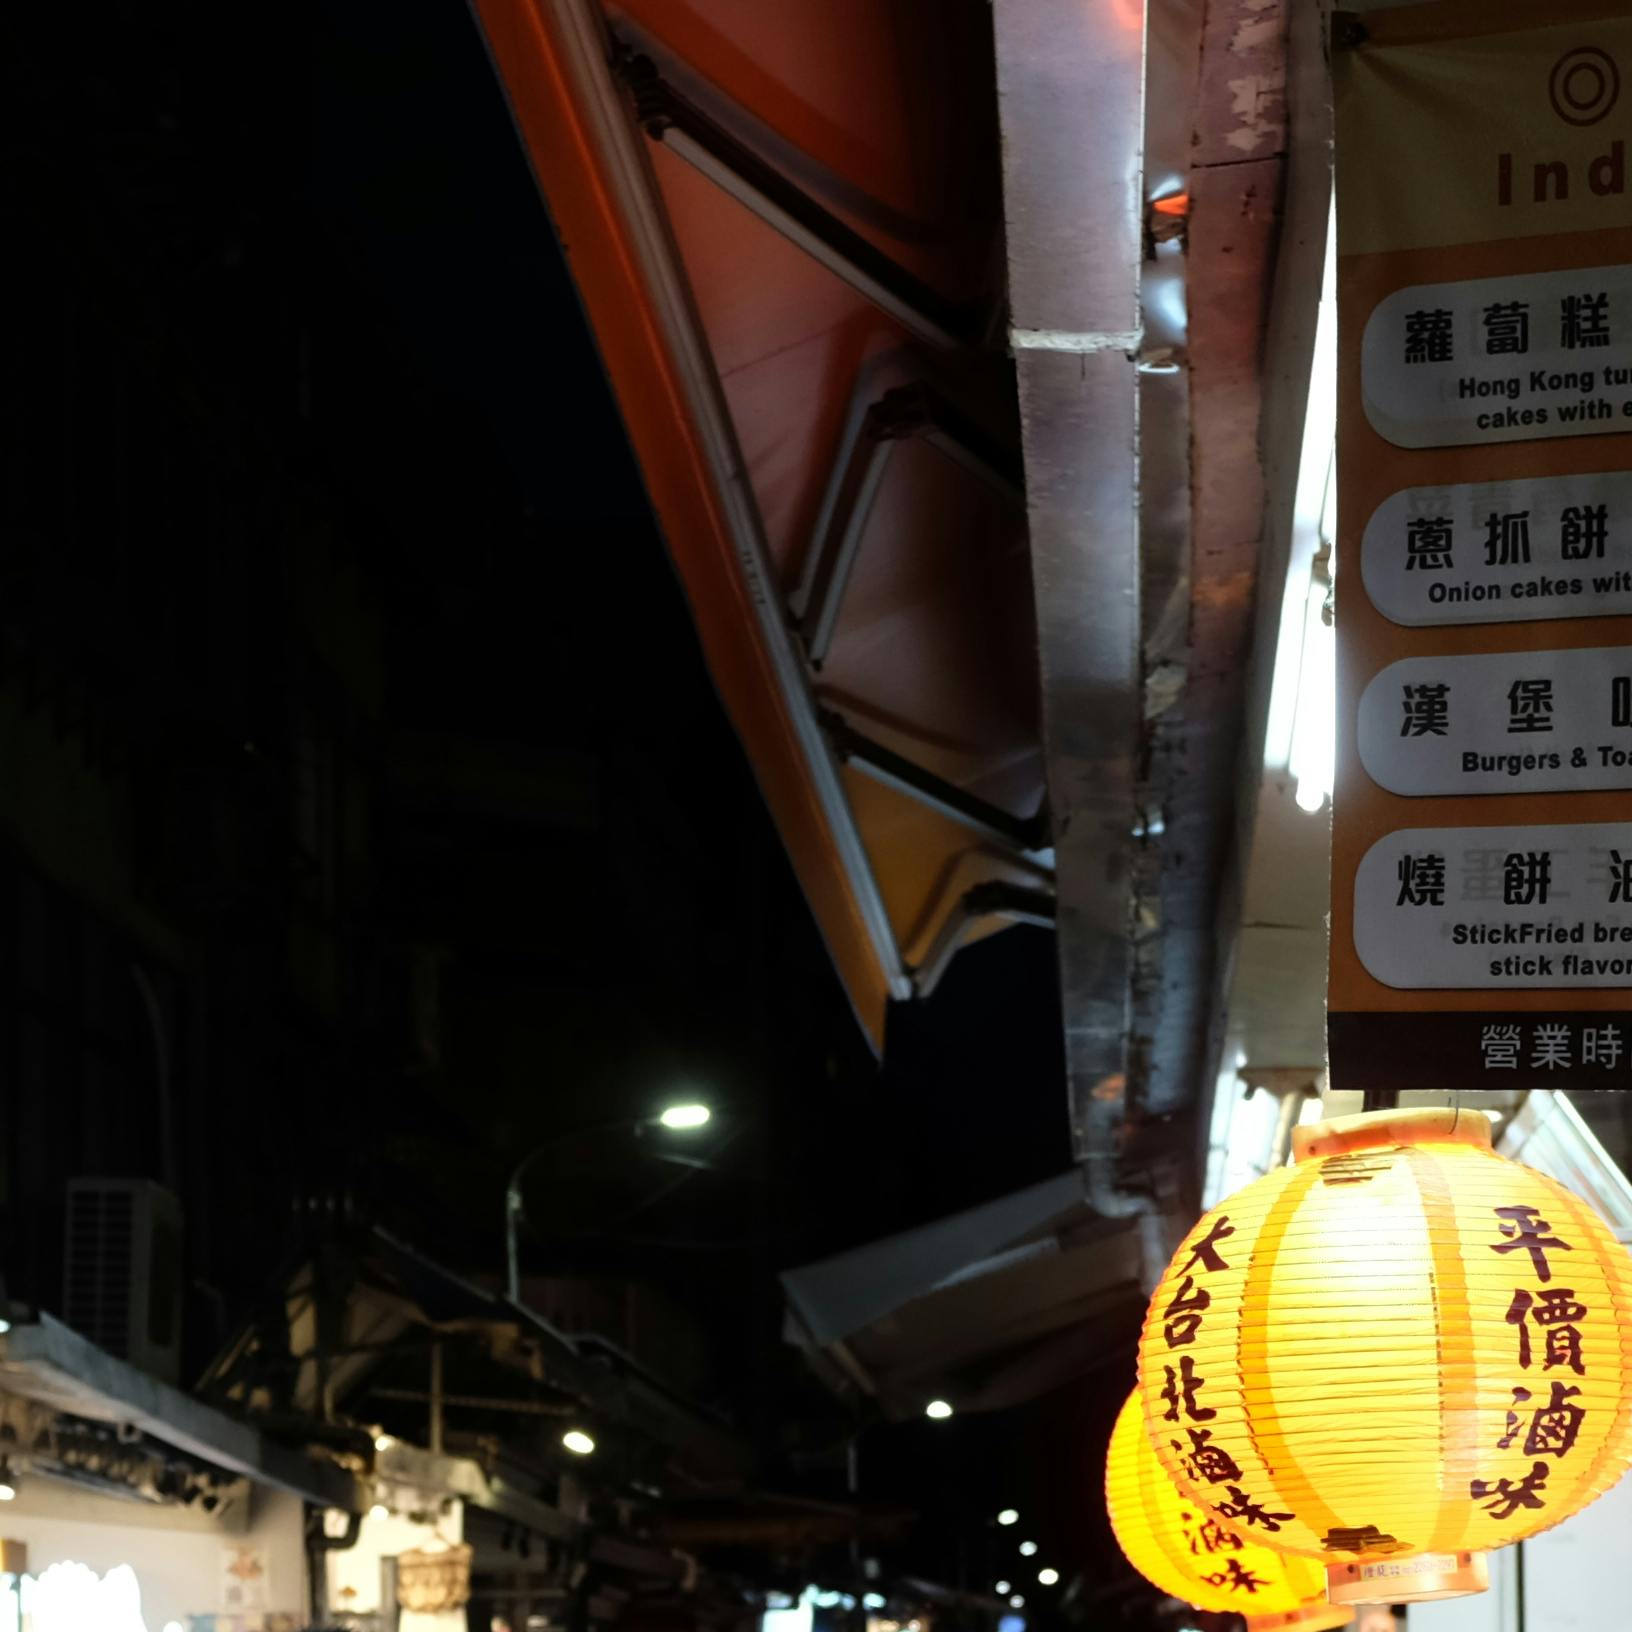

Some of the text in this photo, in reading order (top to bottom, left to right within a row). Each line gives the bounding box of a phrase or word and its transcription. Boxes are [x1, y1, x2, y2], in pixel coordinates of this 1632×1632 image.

[1459, 378, 1520, 399] Hong
[1530, 371, 1594, 393] Kong
[1477, 407, 1548, 430] cakes
[1558, 398, 1612, 422] with
[1429, 581, 1501, 603] Onion
[1511, 576, 1583, 598] cakes
[1462, 752, 1561, 776] Burgers
[1570, 747, 1587, 768] &
[1453, 922, 1584, 944] StickFried
[1490, 955, 1552, 976] stick
[1159, 1213, 1295, 1533] 大台北滷味
[1470, 1204, 1588, 1521] 平價滷味
